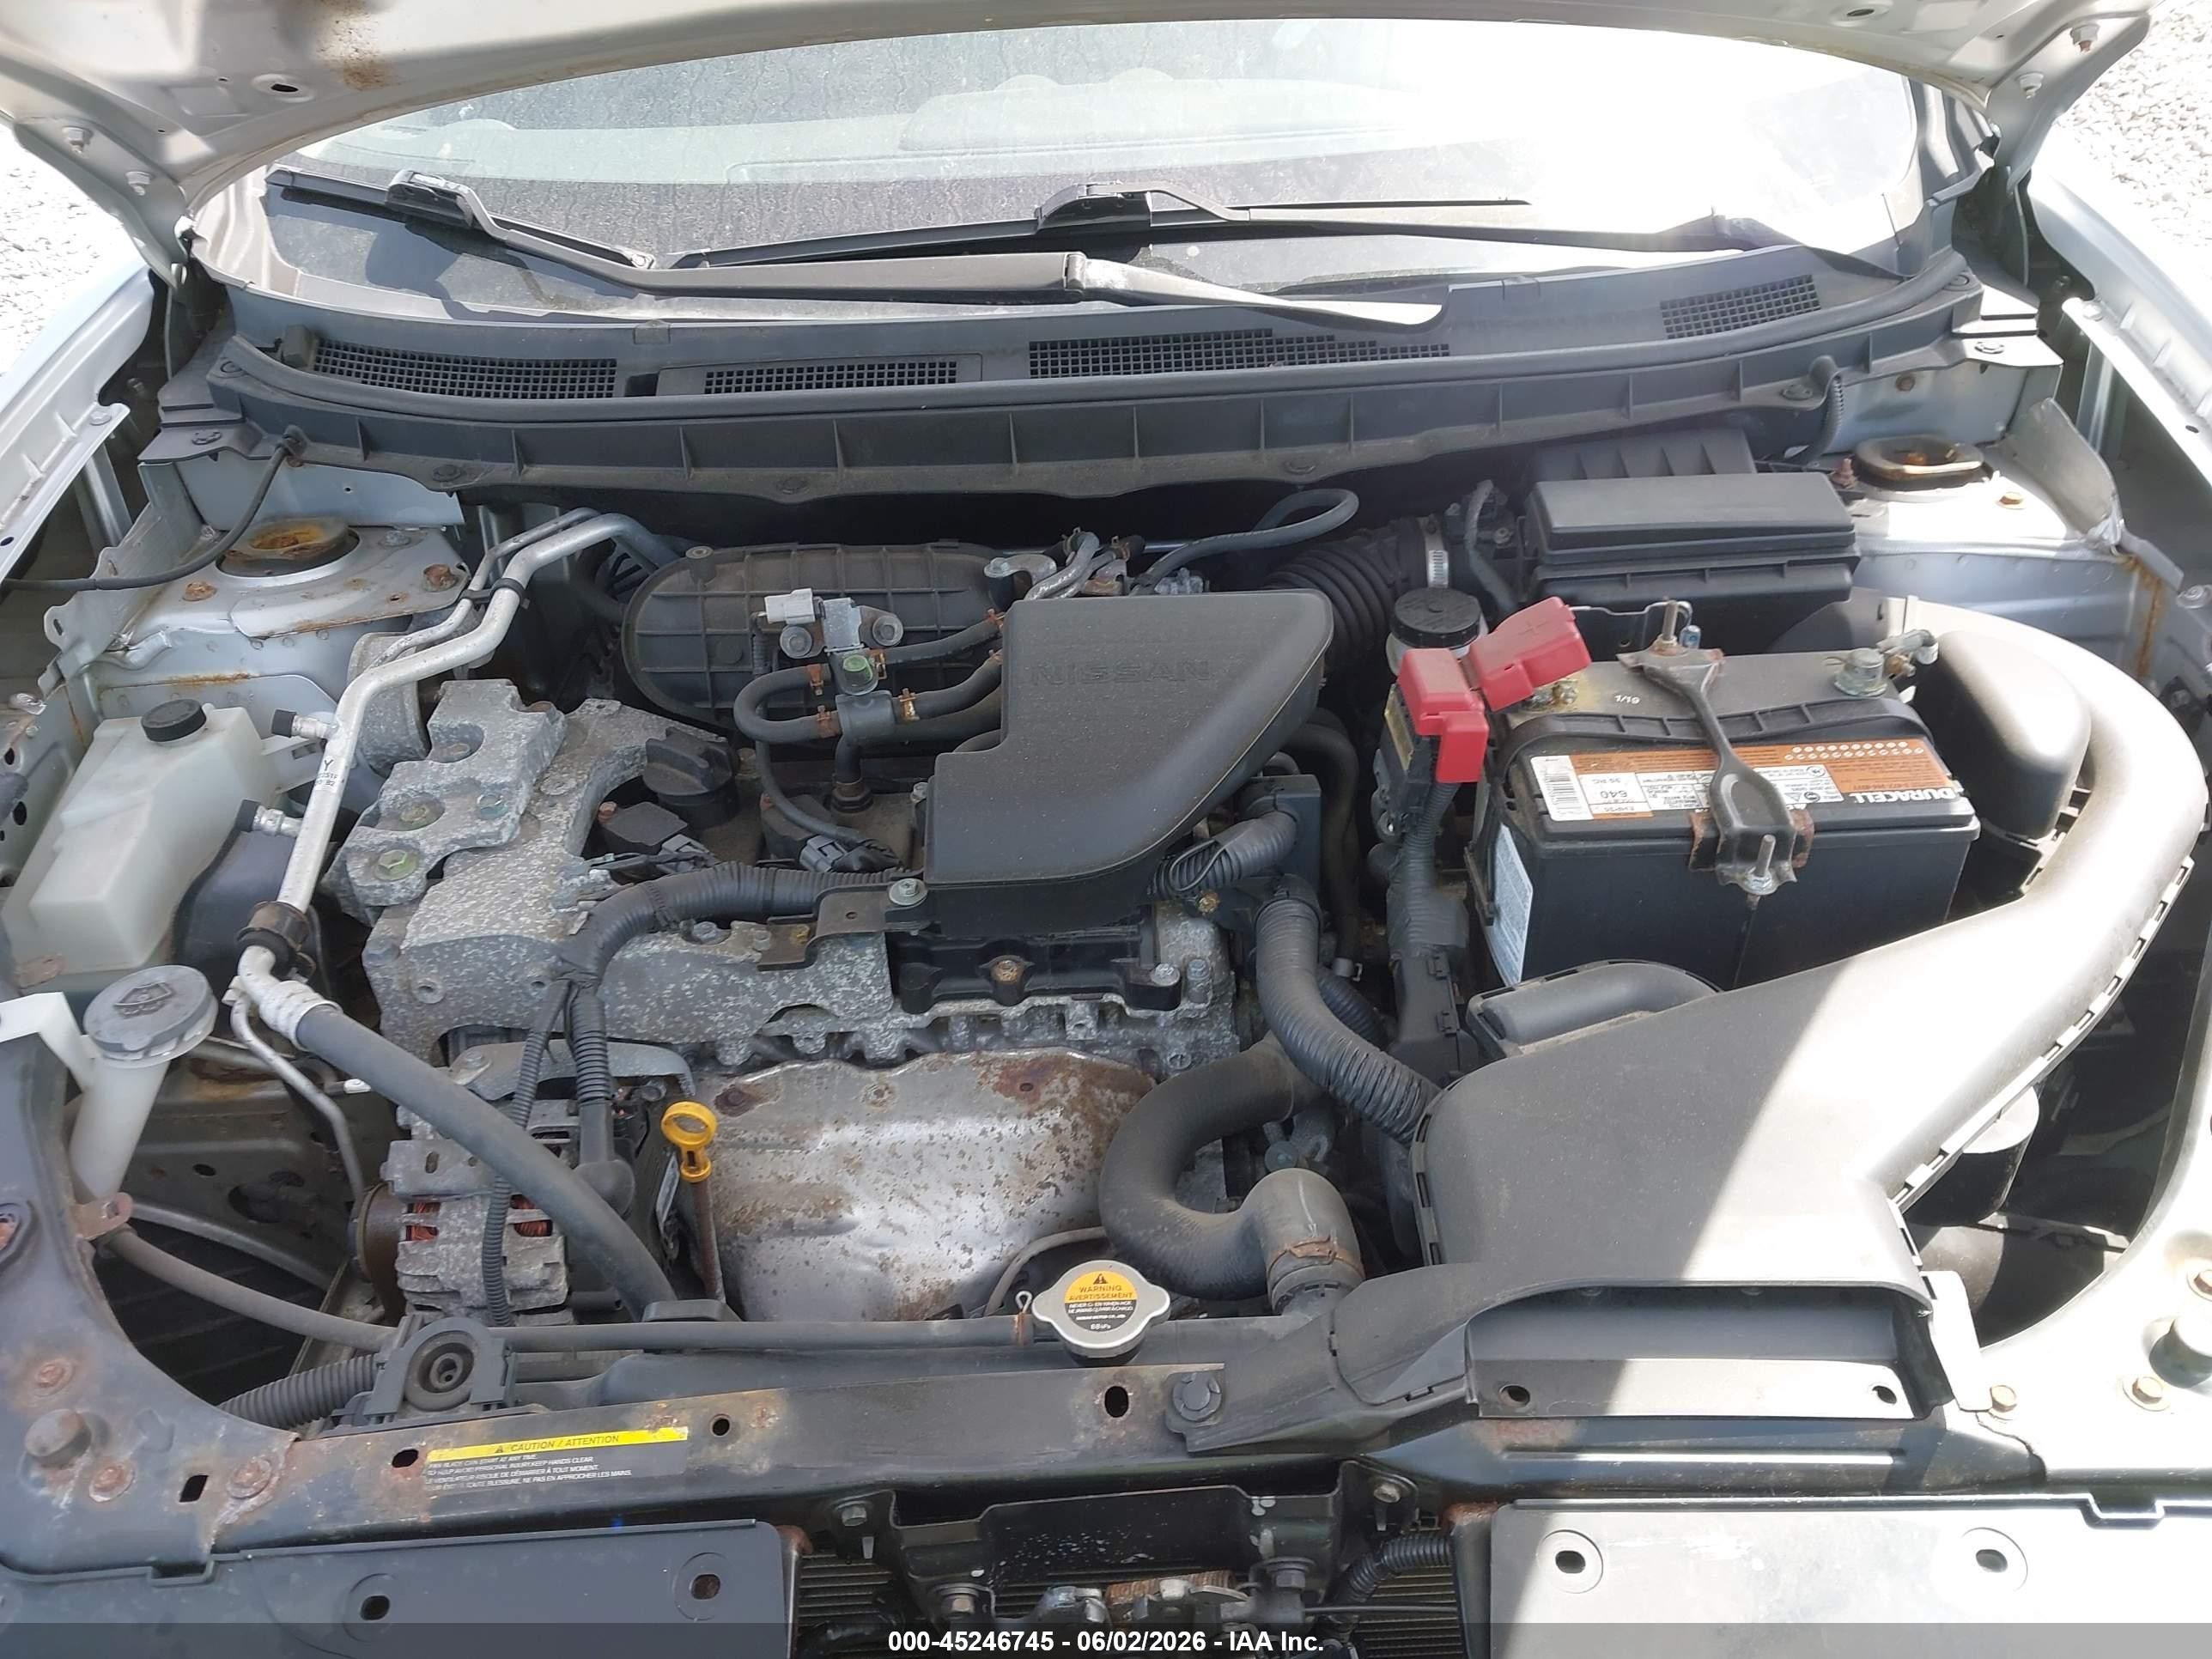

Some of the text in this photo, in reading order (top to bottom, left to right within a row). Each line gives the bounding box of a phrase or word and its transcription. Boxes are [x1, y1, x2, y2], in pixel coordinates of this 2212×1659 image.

[1030, 659, 1212, 686] NISSAN
[1849, 787, 1956, 804] DURACELL
[1069, 1292, 1133, 1301] AVERTISSEMENT
[510, 1440, 556, 1453] CAUTION
[563, 1435, 620, 1448] ATTENTION
